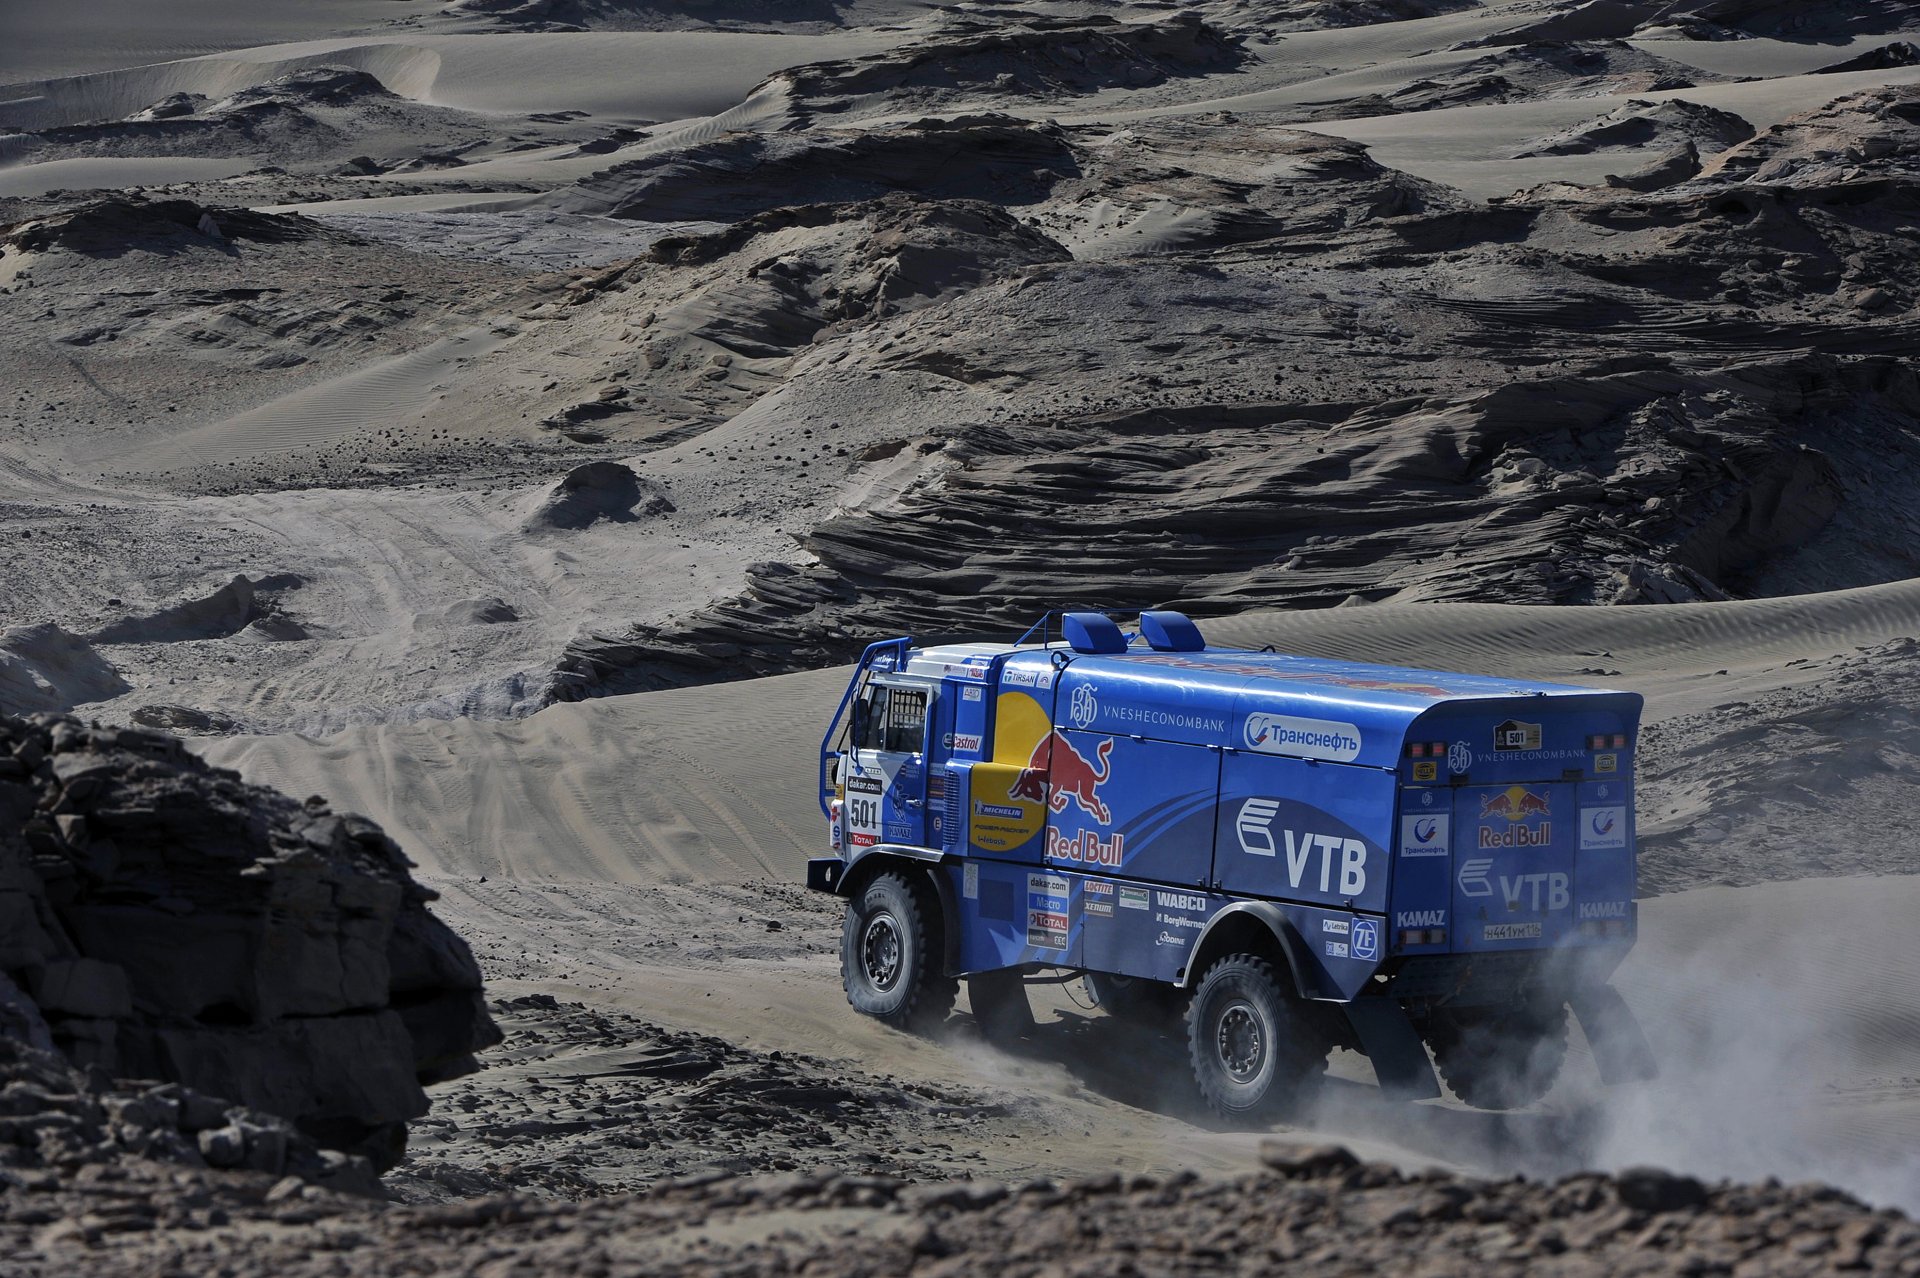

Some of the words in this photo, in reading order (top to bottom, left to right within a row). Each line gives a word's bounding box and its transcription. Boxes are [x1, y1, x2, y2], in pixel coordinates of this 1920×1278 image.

[1103, 705, 1225, 733] VNESHECONOMBANK
[1271, 724, 1358, 751] Транснефть
[1509, 732, 1525, 745] 501
[1477, 749, 1586, 762] VNESHECONOMBANK
[848, 779, 882, 792] dakar.com
[850, 798, 877, 830] 501
[983, 806, 1022, 817] MICHELIN
[1478, 824, 1515, 850] Red
[1516, 821, 1551, 848] Bull
[1045, 826, 1083, 859] Red
[1085, 830, 1124, 867] Bull
[1283, 829, 1368, 897] VTB
[1030, 877, 1067, 891] dakar.com
[1085, 882, 1113, 895] LOCTITE
[1500, 872, 1570, 913] VTB
[1036, 896, 1061, 910] Macro
[1155, 890, 1206, 912] WABCO
[1579, 901, 1626, 919] KAMAZ
[1397, 909, 1446, 928] KAMAZ
